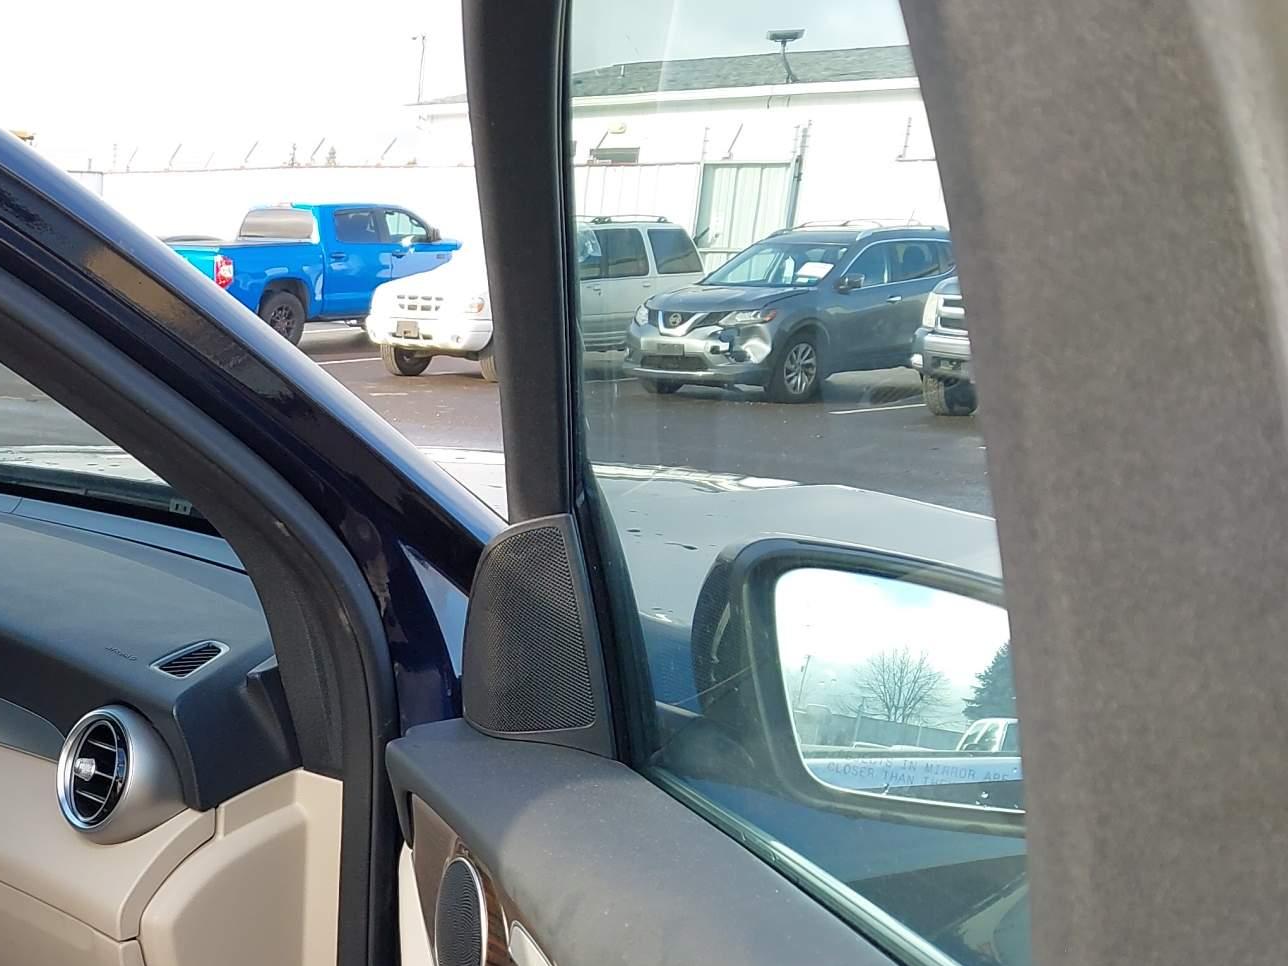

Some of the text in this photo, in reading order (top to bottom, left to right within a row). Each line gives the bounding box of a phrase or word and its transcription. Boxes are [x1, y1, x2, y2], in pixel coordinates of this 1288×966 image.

[826, 762, 875, 778] CLOSER
[882, 770, 916, 785] THAN
[903, 760, 916, 772] IN
[926, 762, 976, 780] MIRROR
